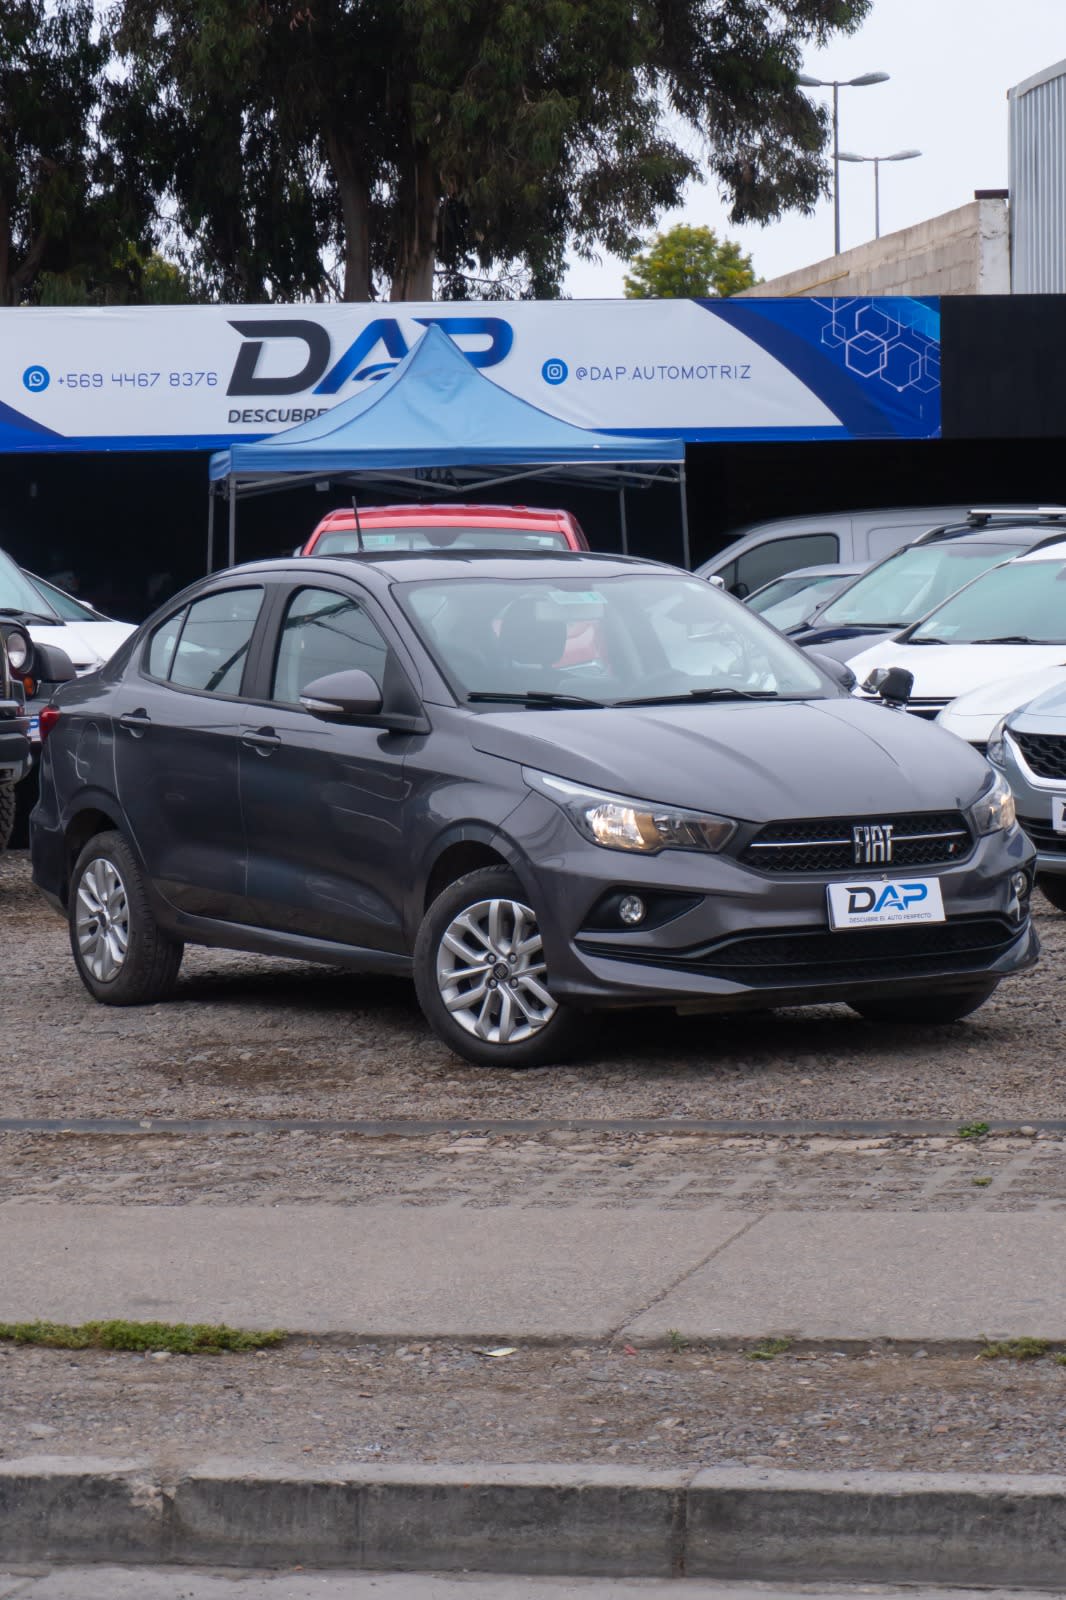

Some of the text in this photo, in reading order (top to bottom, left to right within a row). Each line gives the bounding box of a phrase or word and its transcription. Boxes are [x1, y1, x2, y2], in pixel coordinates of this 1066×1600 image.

[226, 317, 514, 397] DAP
[575, 364, 752, 381] @DAP.AUTOMOTRIZ
[57, 371, 218, 389] +569 4467 8376
[853, 825, 893, 863] FIAT
[845, 883, 928, 914] DAP
